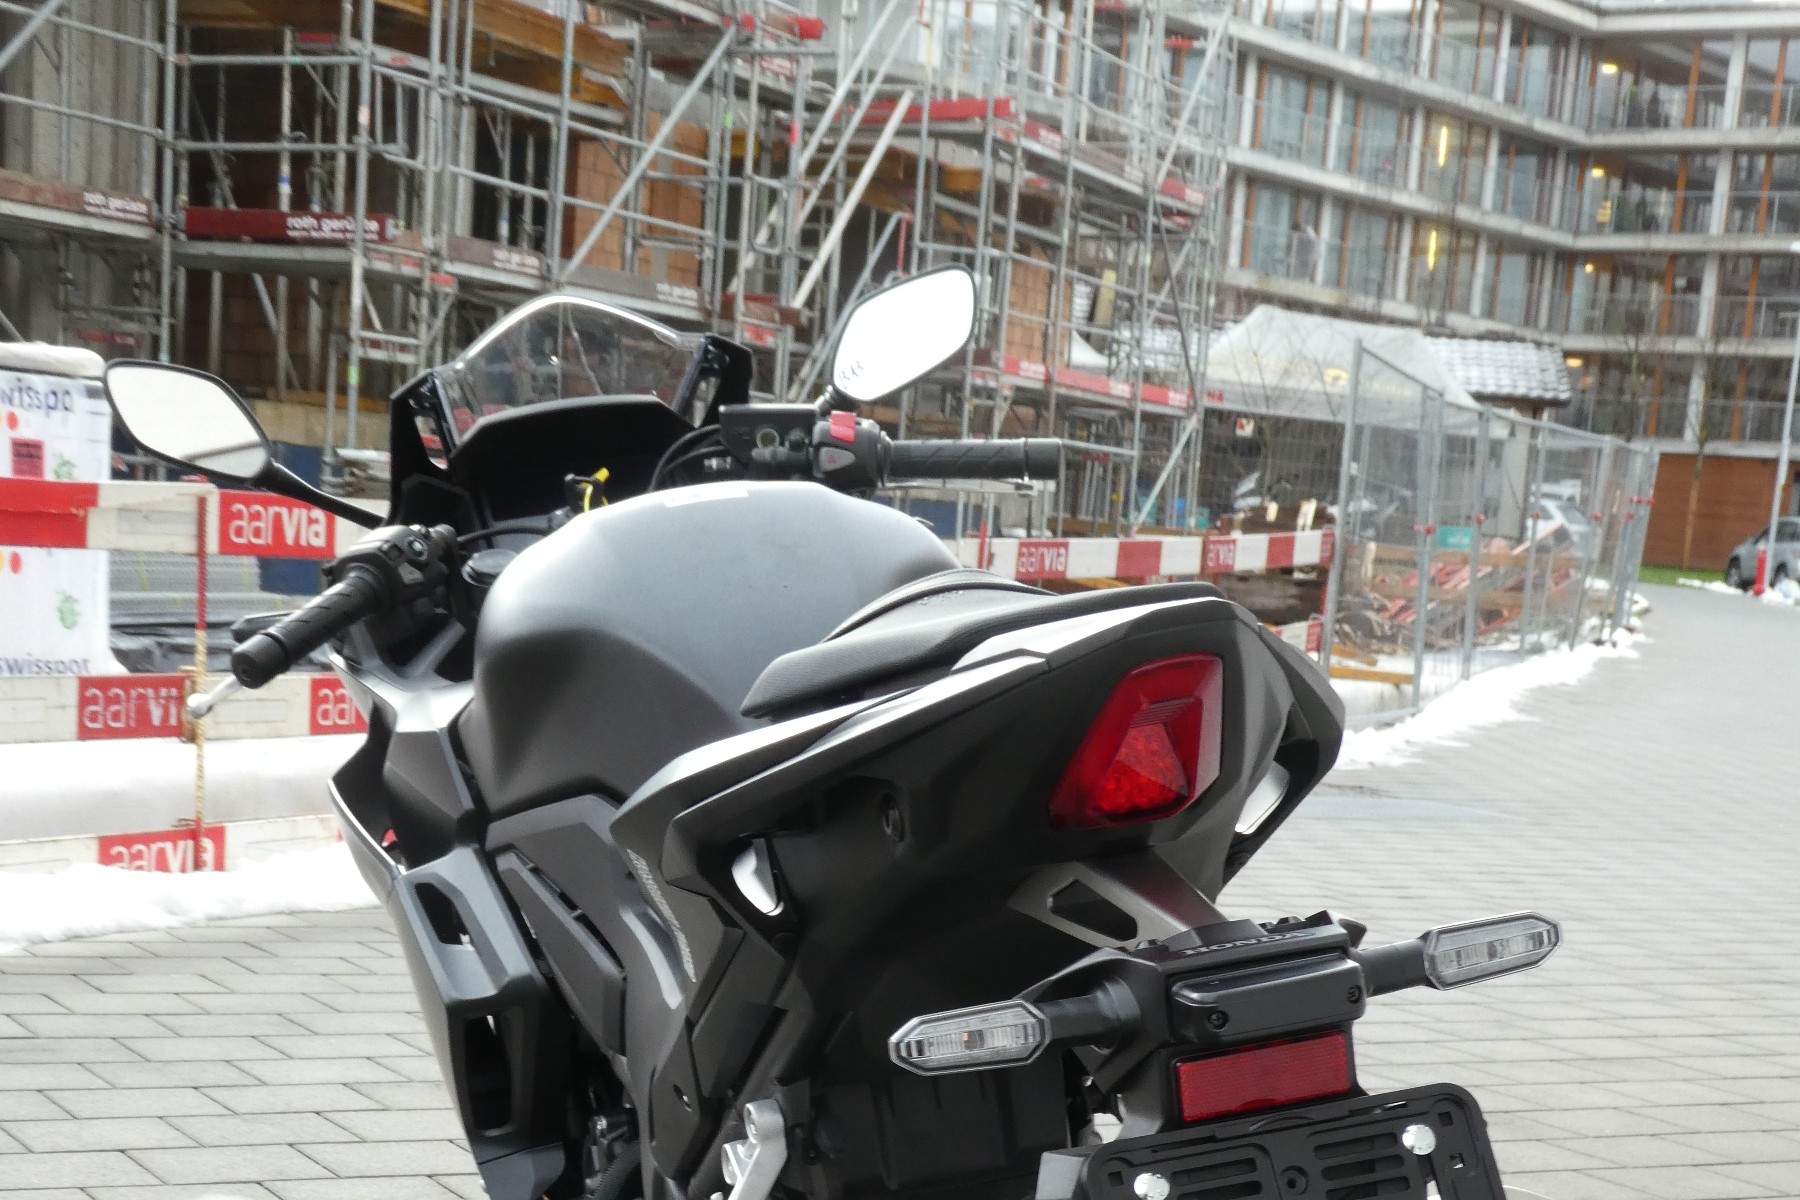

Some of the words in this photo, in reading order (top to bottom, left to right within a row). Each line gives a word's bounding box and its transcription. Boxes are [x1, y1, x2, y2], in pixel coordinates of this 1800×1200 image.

[229, 503, 326, 547] aarvia
[1018, 546, 1067, 573] aarvia
[82, 687, 179, 729] aarvi
